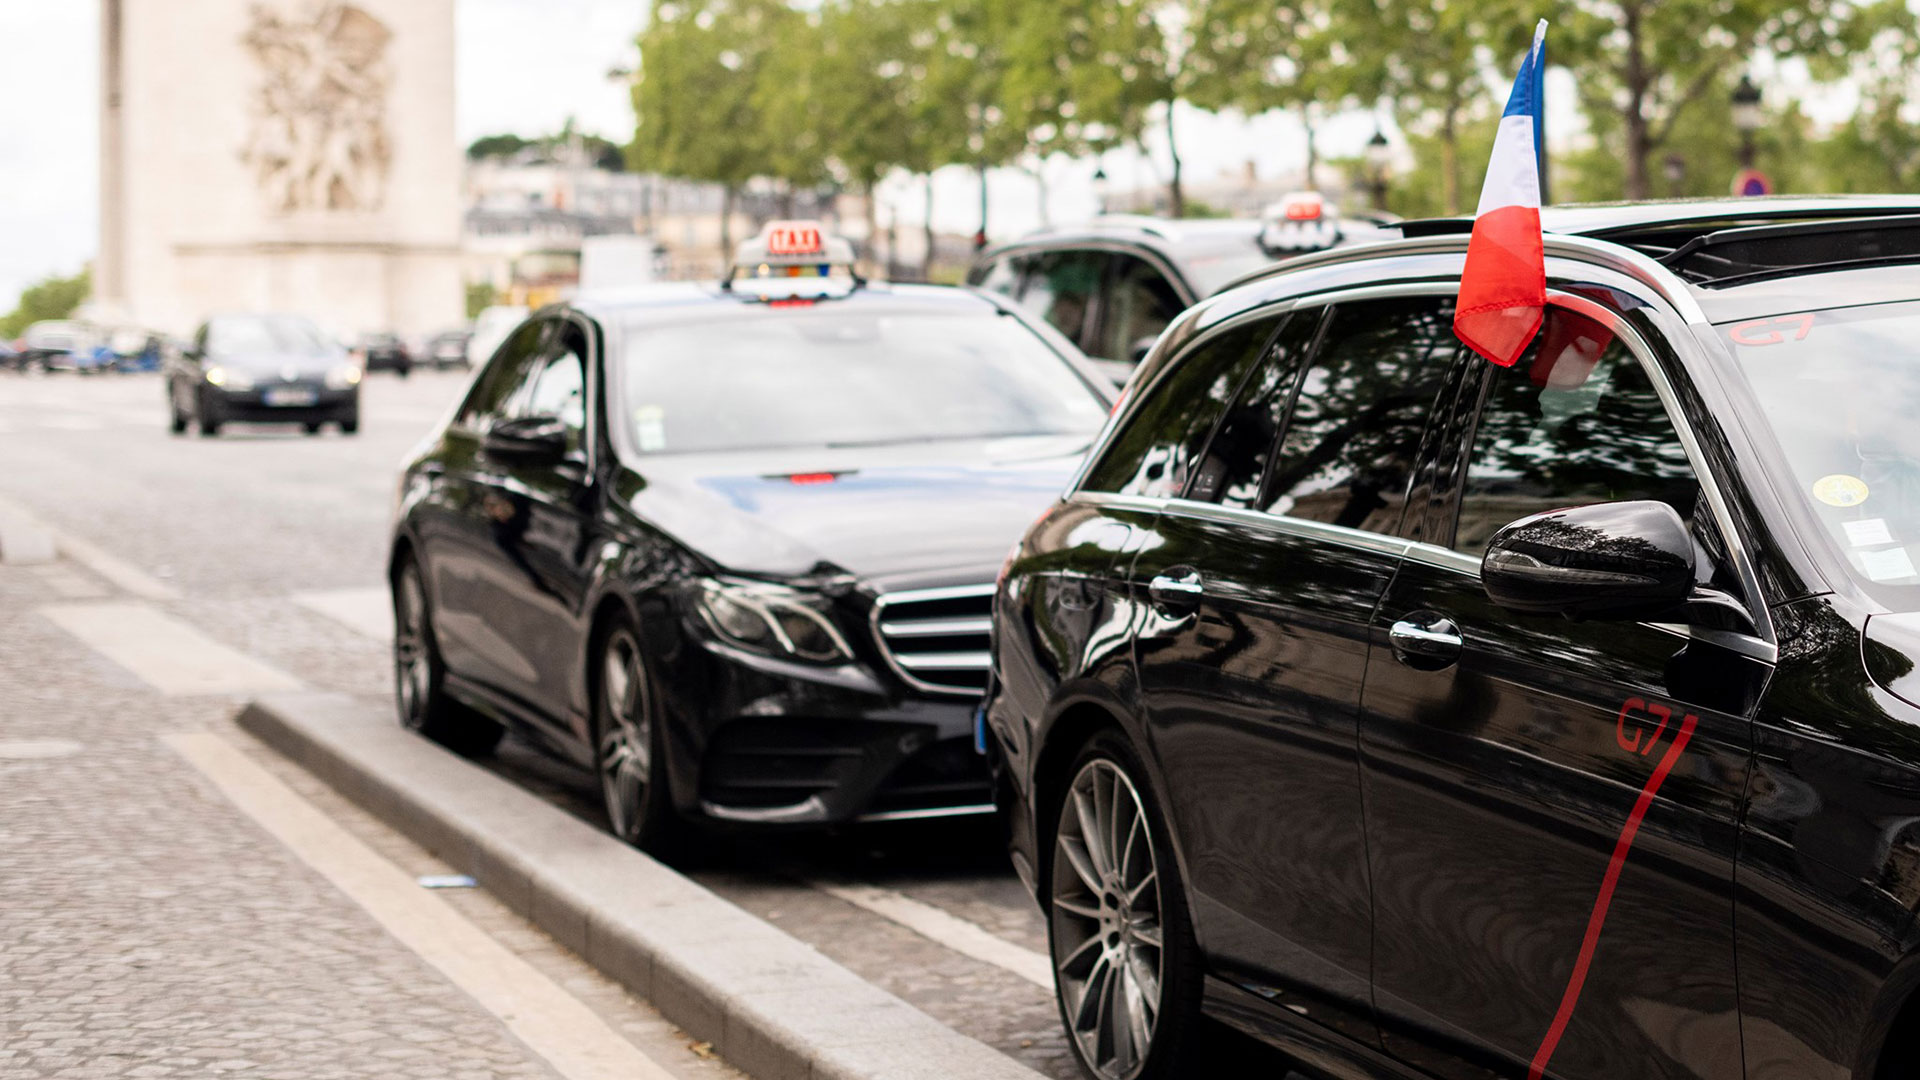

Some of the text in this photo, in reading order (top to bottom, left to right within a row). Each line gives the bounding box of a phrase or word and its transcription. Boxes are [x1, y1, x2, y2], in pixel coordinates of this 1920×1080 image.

[772, 229, 820, 249] TAXI
[1729, 313, 1816, 346] G7
[1617, 697, 1672, 756] G7
